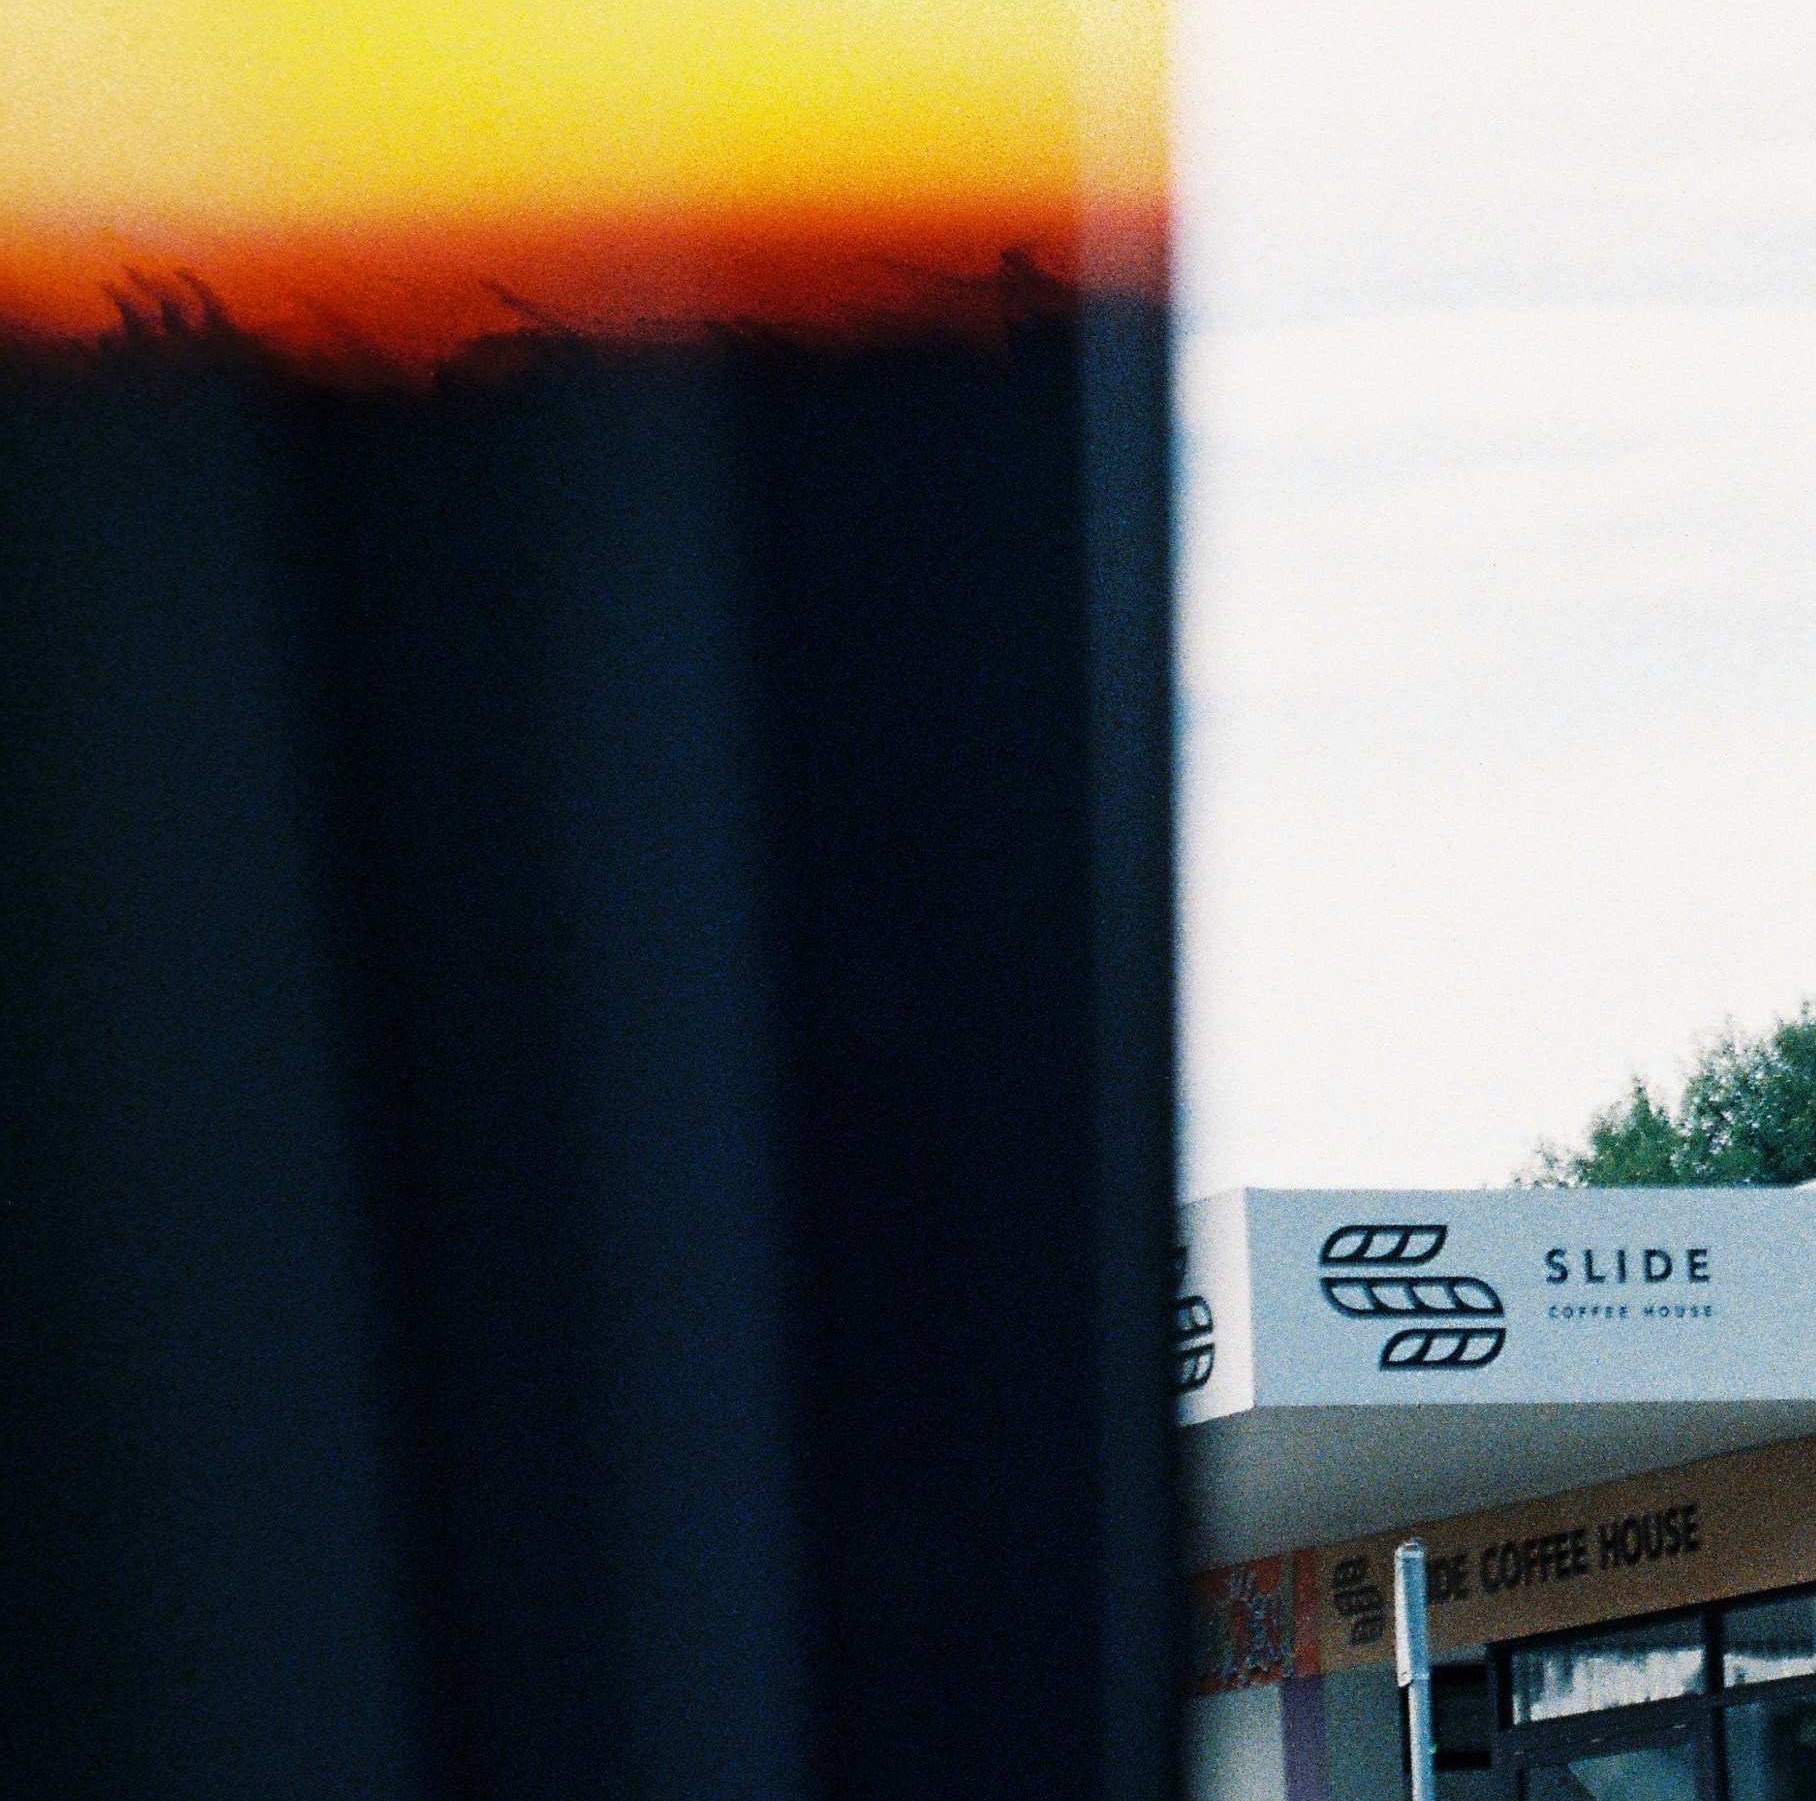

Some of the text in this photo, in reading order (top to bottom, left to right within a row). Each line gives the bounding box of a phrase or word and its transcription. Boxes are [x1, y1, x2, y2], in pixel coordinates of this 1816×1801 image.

[1545, 1247, 1711, 1284] SLIDE
[1547, 1304, 1714, 1319] COFFEE HOUSE
[1479, 1527, 1588, 1595] COFFEE
[1599, 1504, 1702, 1572] HOUSE
